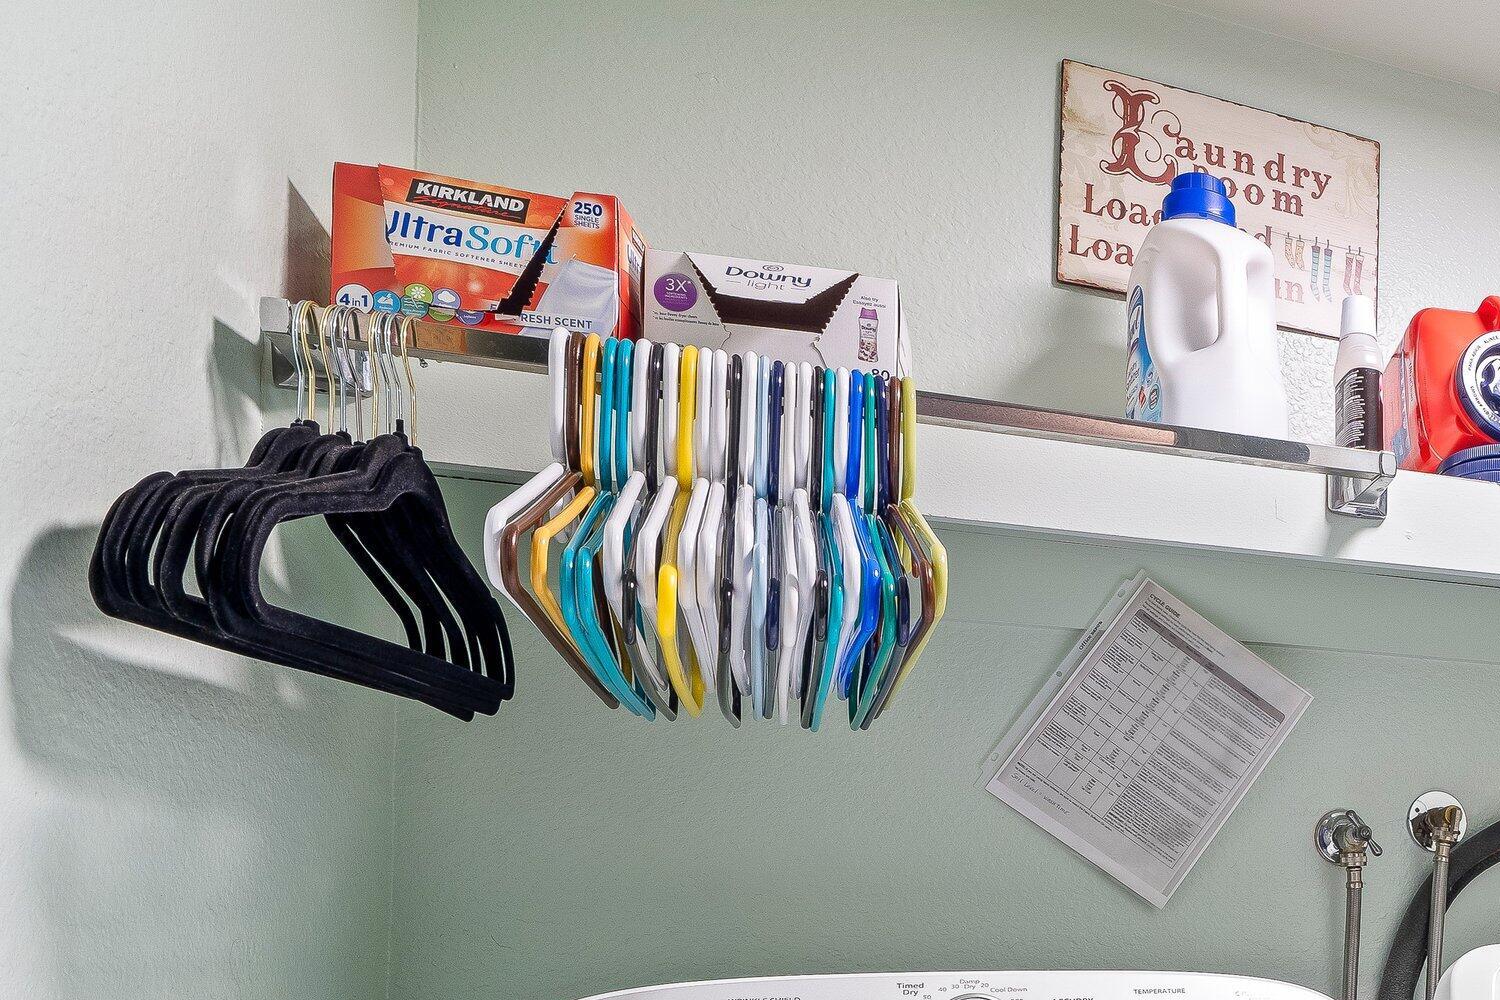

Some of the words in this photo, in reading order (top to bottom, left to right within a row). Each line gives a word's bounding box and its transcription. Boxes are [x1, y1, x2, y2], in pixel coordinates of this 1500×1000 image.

[1099, 80, 1332, 200] Laundry
[416, 182, 524, 212] KIRKLAND
[1083, 182, 1162, 226] Loa
[574, 201, 603, 217] 250
[574, 220, 600, 229] SHEETS
[575, 214, 600, 223] SINGLE
[389, 240, 420, 250] REMIUM
[422, 246, 452, 256] FABRIC
[455, 252, 496, 264] SOFTENER
[1068, 224, 1134, 266] Loa
[725, 266, 812, 288] Downy
[747, 280, 786, 291] light
[339, 293, 350, 306] 4
[352, 298, 361, 308] in
[361, 294, 368, 308] 1
[519, 313, 551, 326] RESH
[554, 317, 593, 331] SCENT
[902, 989, 919, 997] Dry
